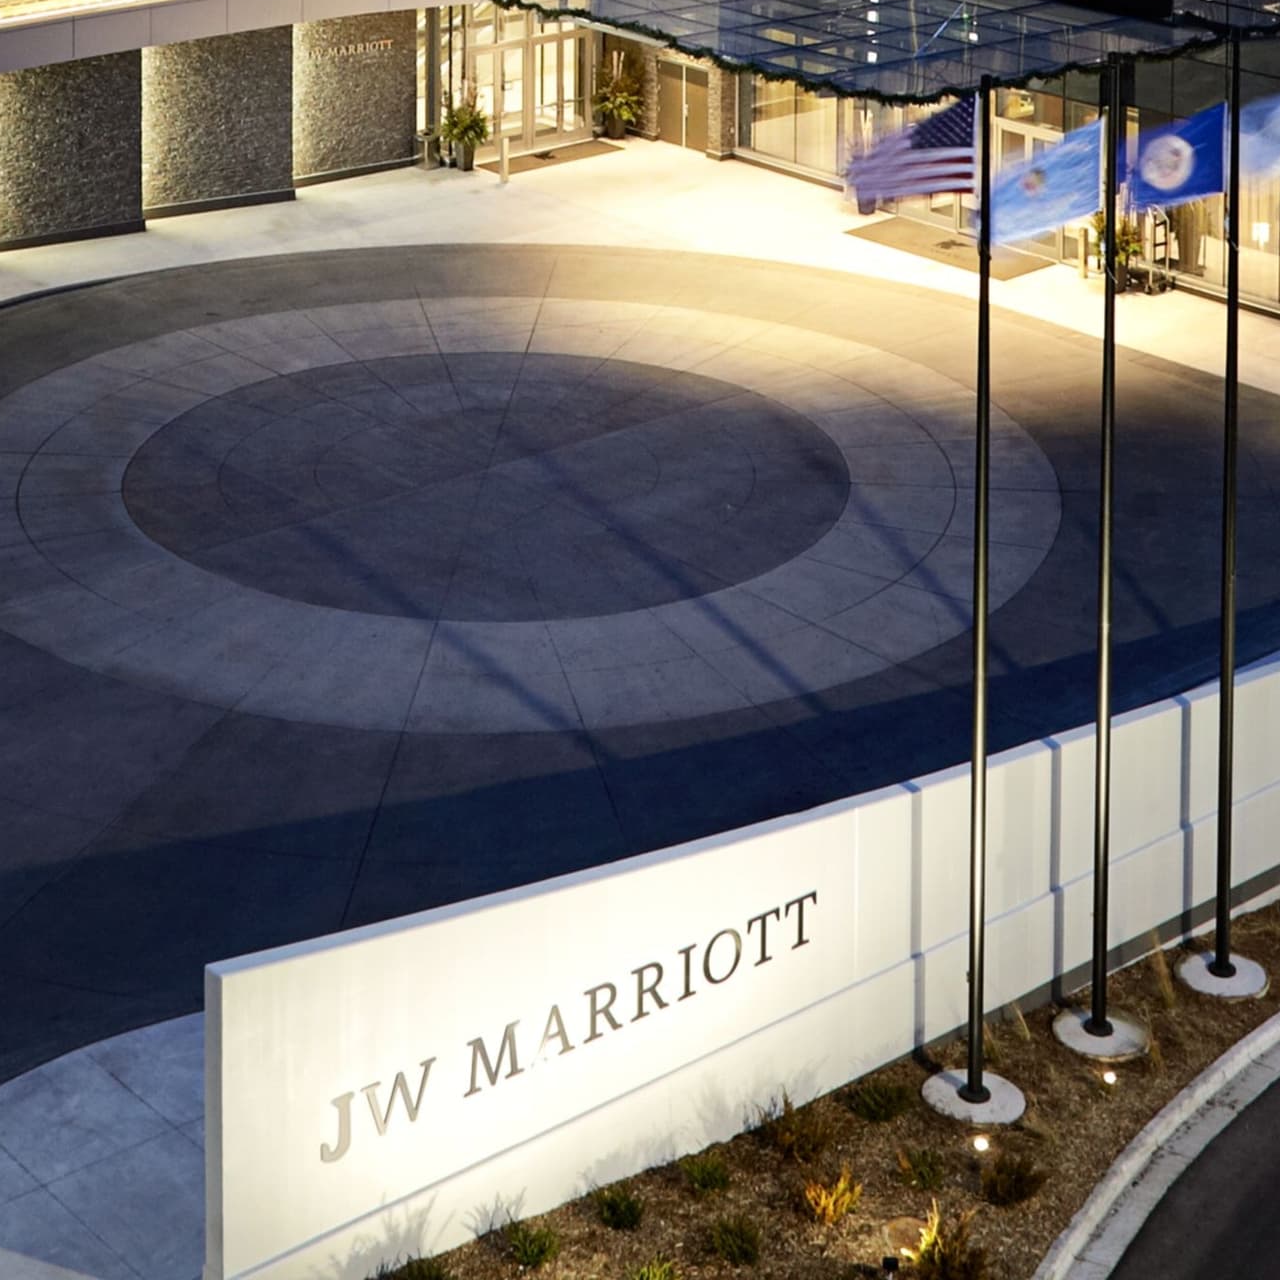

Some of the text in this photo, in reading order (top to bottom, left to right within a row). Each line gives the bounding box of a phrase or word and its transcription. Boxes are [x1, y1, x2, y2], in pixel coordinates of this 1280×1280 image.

[327, 39, 394, 57] MARRIOTT
[320, 890, 818, 1163] JW MARRIOTT
